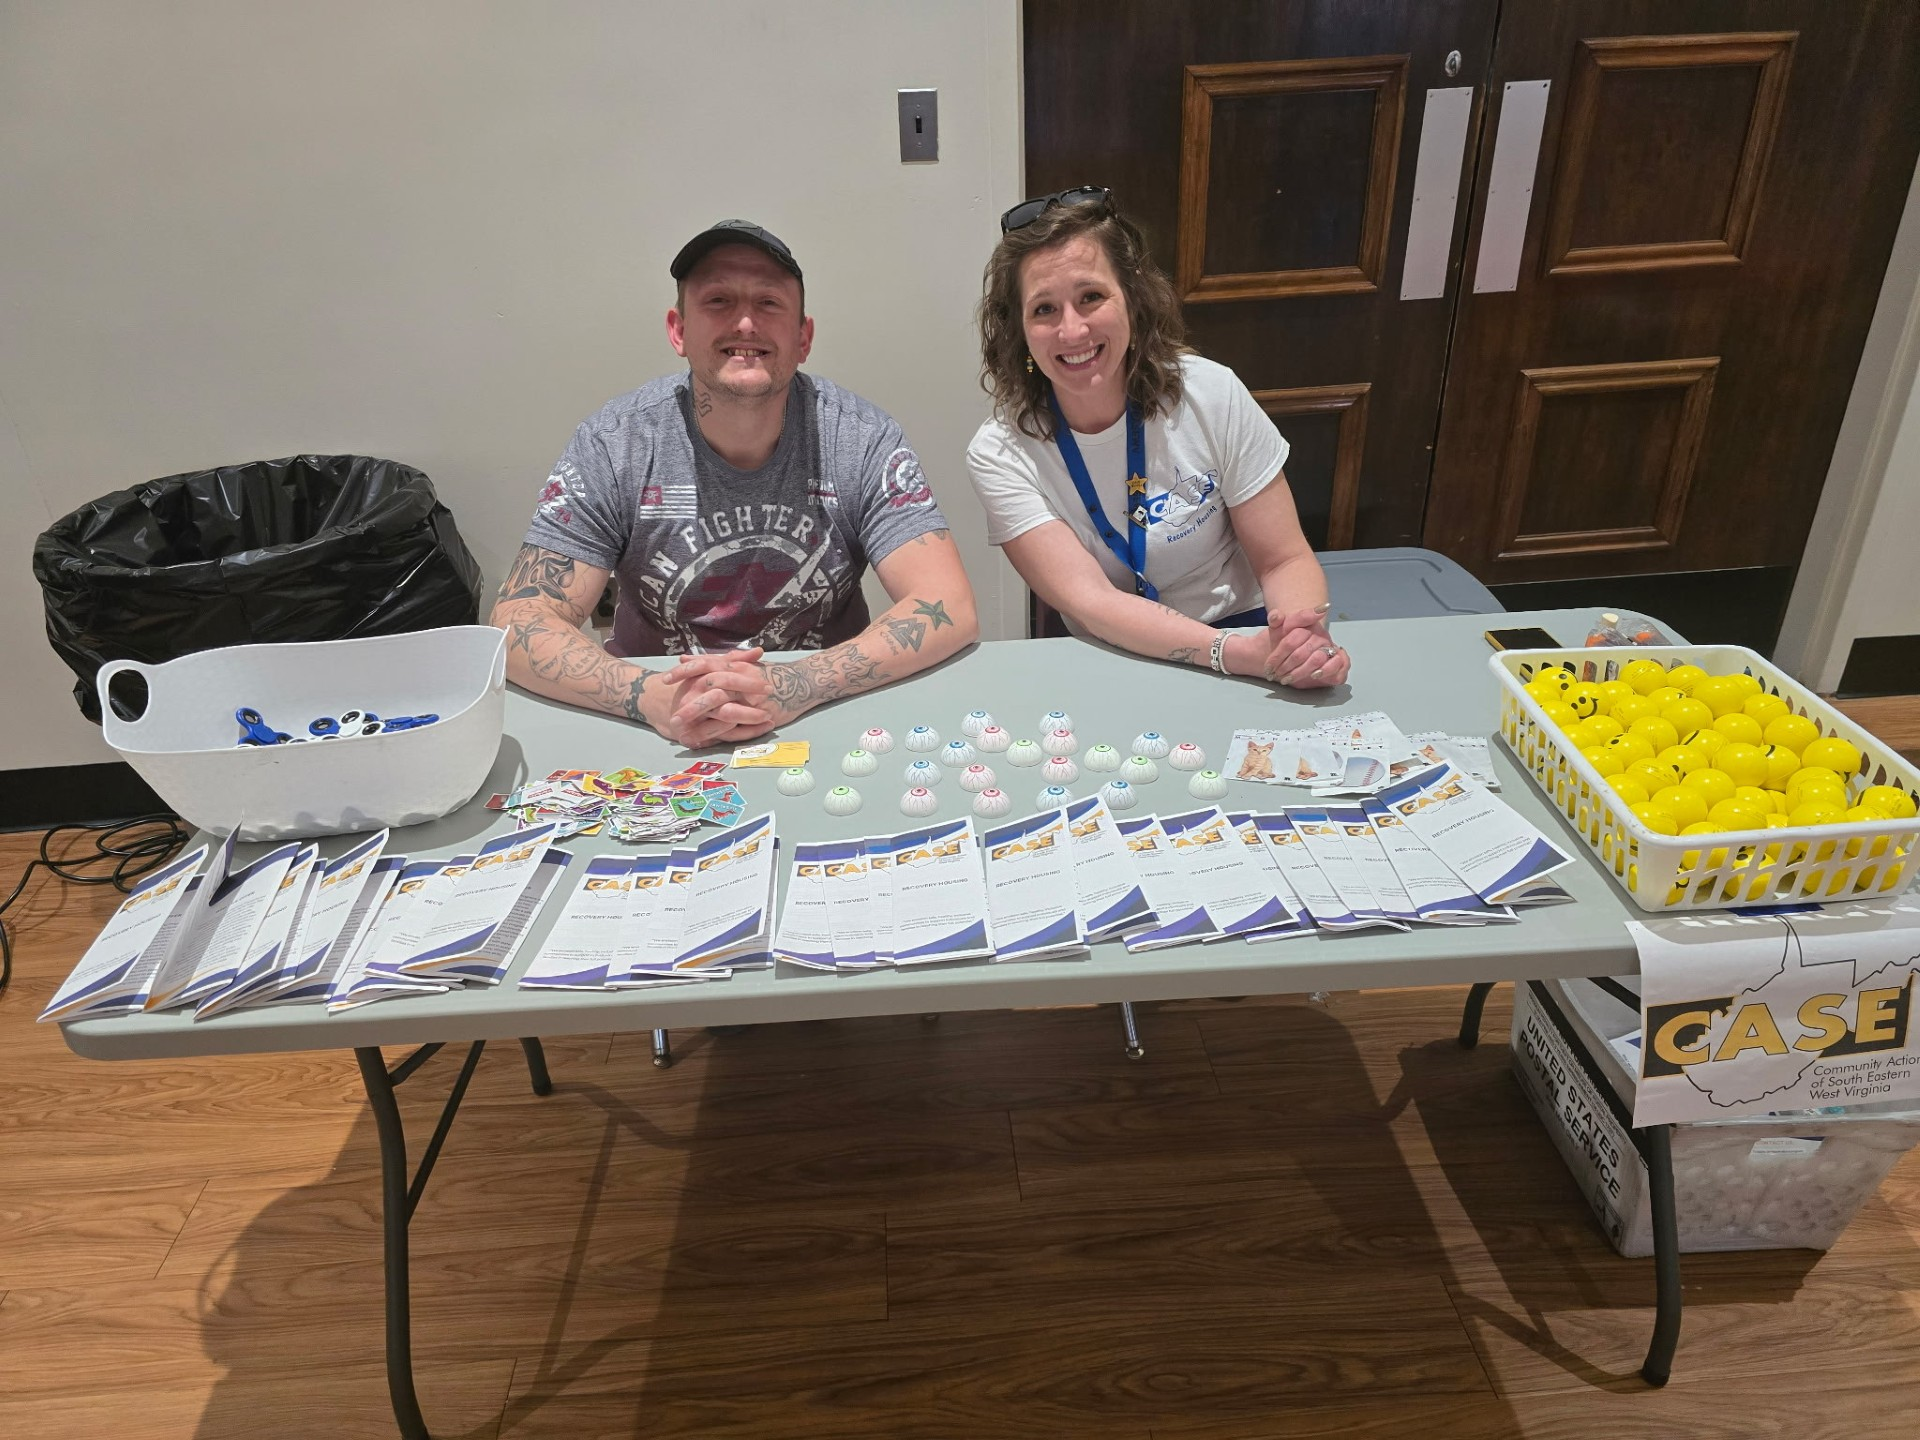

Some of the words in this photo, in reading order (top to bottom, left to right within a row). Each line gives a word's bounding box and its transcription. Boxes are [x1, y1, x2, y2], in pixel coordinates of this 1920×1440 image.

[679, 504, 815, 554] FIGHTER
[1167, 526, 1197, 543] Recovery
[1197, 505, 1218, 527] Housing
[1401, 785, 1464, 814] CASE
[1431, 820, 1466, 839] RECOVERY
[699, 842, 760, 871] CASE
[898, 842, 961, 864] CASE
[992, 834, 1055, 859] CASE
[1086, 851, 1115, 863] HOUSING
[473, 846, 535, 871] CASE
[1214, 861, 1244, 871] HOUSING
[901, 882, 937, 891] RECOVERY
[938, 878, 969, 887] HOUSING
[995, 875, 1030, 889] RECOVERY
[1031, 869, 1061, 880] HOUSING
[833, 897, 869, 905] RECOVERY
[1653, 984, 1903, 1066] CASE
[1813, 1058, 1882, 1077] Community
[1811, 1076, 1825, 1089] of
[1828, 1073, 1863, 1088] South
[1866, 1069, 1911, 1083] Eastern
[1525, 1014, 1567, 1088] UNITED
[1567, 1081, 1619, 1171] STATES
[1809, 1088, 1841, 1101] West
[1844, 1082, 1891, 1098] Virginia
[1518, 1028, 1563, 1108] POSTAL
[1563, 1102, 1620, 1203] SERVICE
